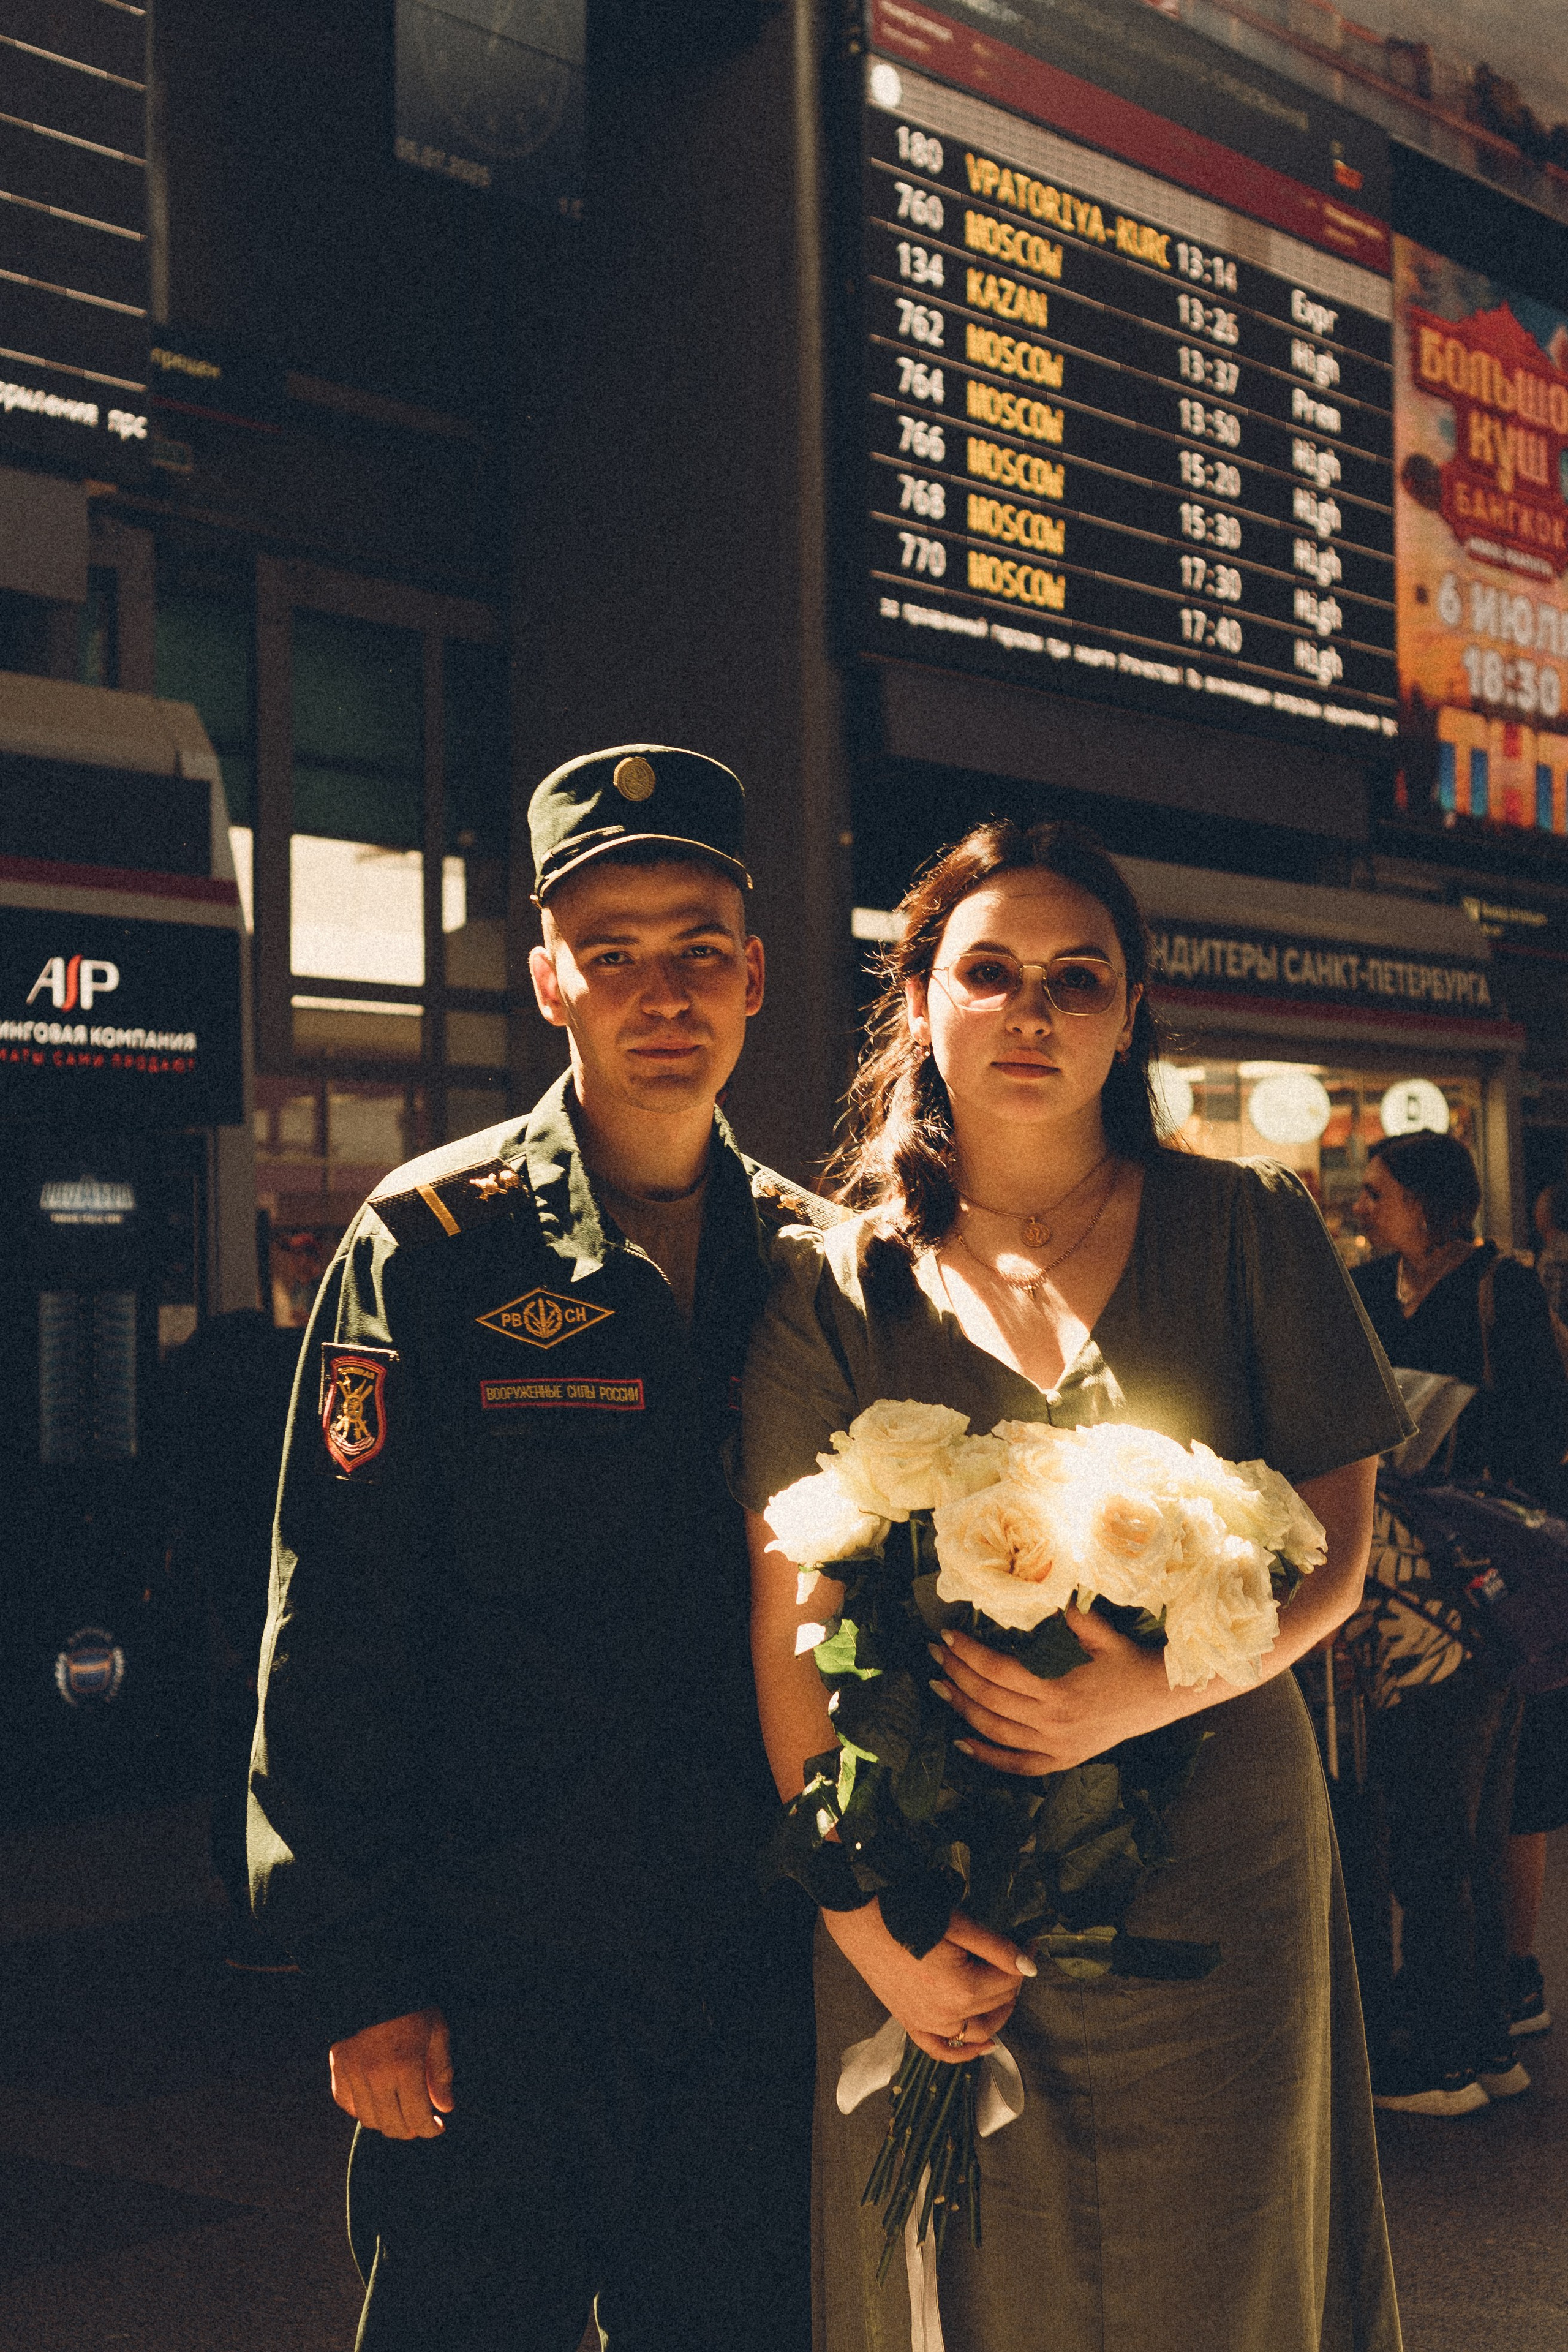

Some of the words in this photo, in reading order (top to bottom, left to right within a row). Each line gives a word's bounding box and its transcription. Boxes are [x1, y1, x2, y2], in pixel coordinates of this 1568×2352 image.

[897, 126, 943, 173] 180
[1176, 243, 1238, 292] 13:14
[1291, 290, 1338, 337] Expr
[895, 182, 943, 230] 760
[965, 210, 1063, 279] MOSCOW
[1291, 339, 1339, 388] High
[898, 242, 944, 287] 134
[967, 268, 1047, 328] KAZAN
[1178, 347, 1239, 393] 13:37
[896, 298, 944, 346] 762
[967, 323, 1064, 388] MOSCOW
[1179, 399, 1240, 446] 13:50
[1293, 439, 1341, 489] High
[897, 357, 944, 403] 764
[967, 380, 1064, 443] MOSCOW
[1179, 451, 1240, 496] 15:20
[1293, 488, 1341, 538] High
[1469, 409, 1549, 492] КУШ
[899, 416, 945, 461] 766
[967, 437, 1065, 499] MOSCOW
[1180, 503, 1241, 548] 15:30
[1294, 539, 1341, 586] High
[1455, 481, 1566, 549] БАНГКОК
[899, 474, 945, 519] 768
[968, 494, 1065, 554] MOSCOW
[1180, 556, 1242, 600] 17:30
[1294, 588, 1342, 636] High
[899, 532, 946, 576] 770
[968, 551, 1066, 609] MOSCOW
[1180, 609, 1242, 652] 17:40
[1294, 640, 1343, 687] High
[1438, 571, 1462, 627] 6
[1463, 644, 1561, 718] 18:30
[1283, 947, 1491, 1006] САНКТ-ПЕТЕРБУРГА
[53, 1050, 104, 1068] САМИ
[111, 1054, 196, 1074] ПРОДАЮТ
[90, 1025, 197, 1052] КОМПАНИЯ
[500, 1313, 523, 1328] РВ
[564, 1306, 587, 1324] СН
[486, 1384, 562, 1401] ВООРУЖЕННЫЕ
[567, 1384, 596, 1400] СИЛЫ
[600, 1385, 639, 1402] РОССИИ
